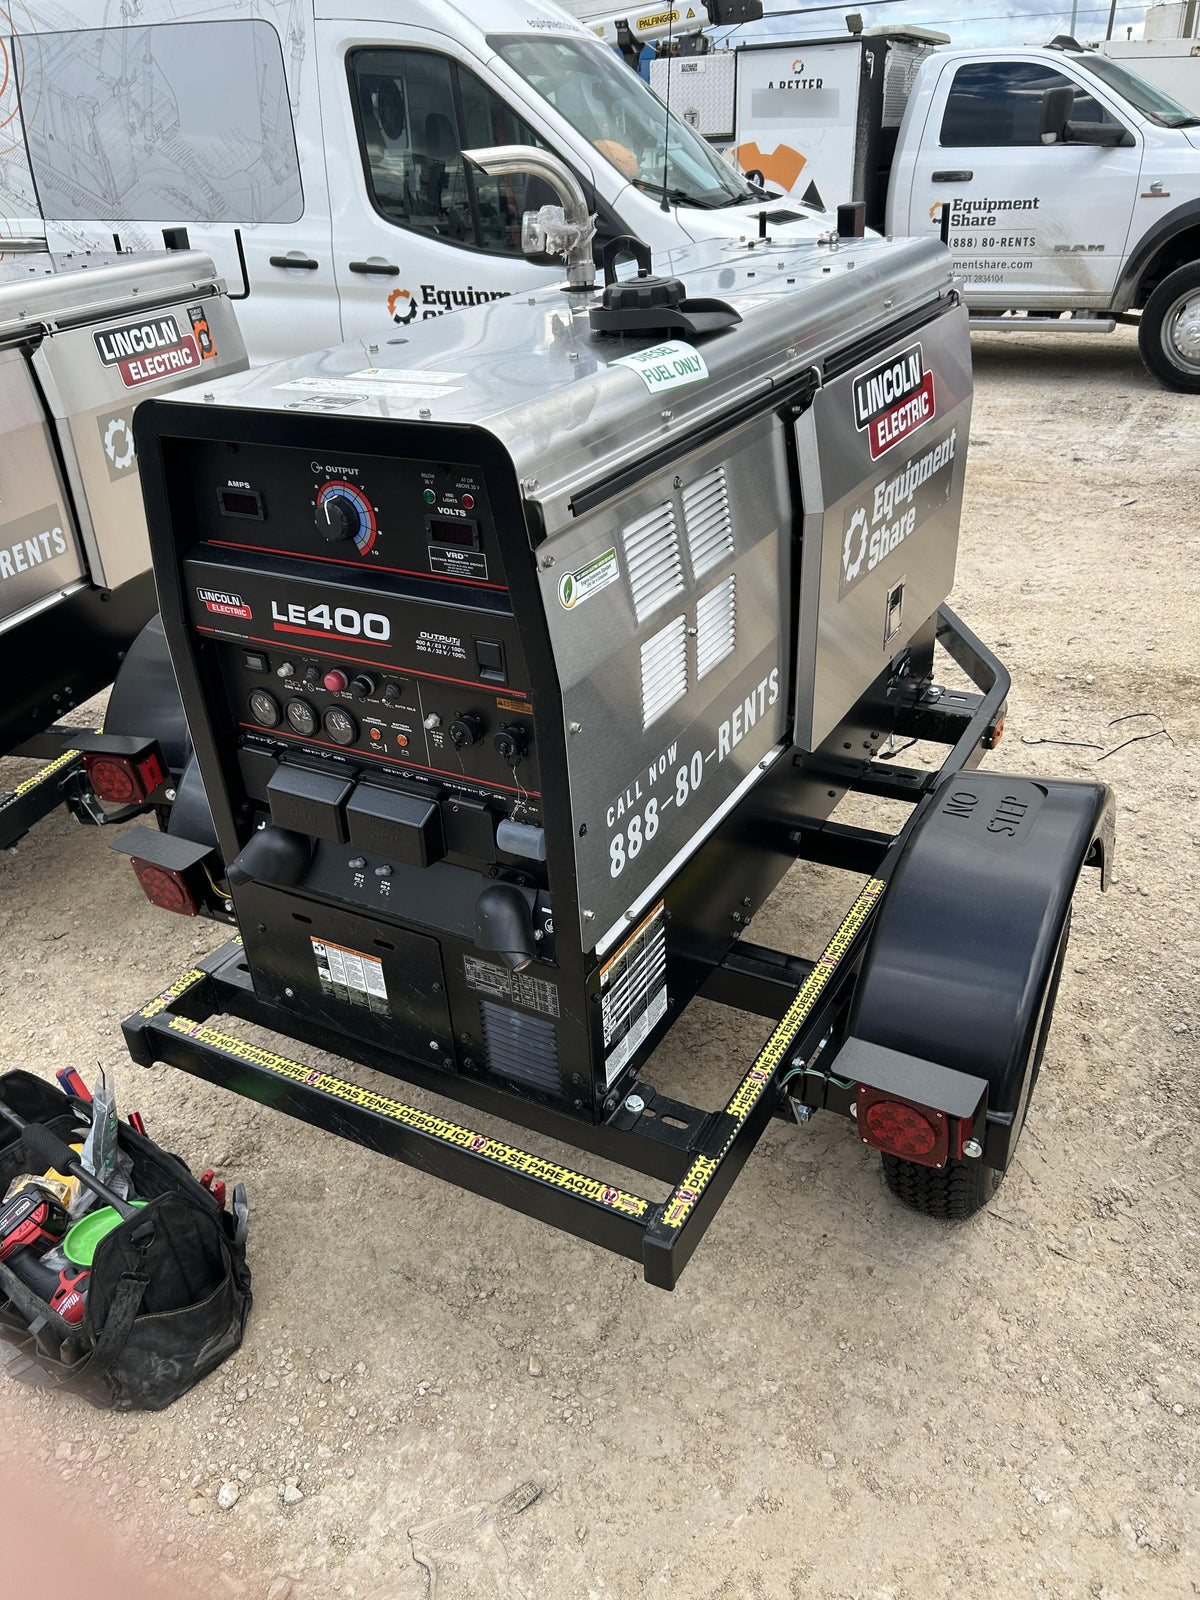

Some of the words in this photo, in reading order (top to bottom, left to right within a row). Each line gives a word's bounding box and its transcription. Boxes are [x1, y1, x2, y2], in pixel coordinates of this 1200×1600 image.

[639, 13, 677, 28] PALFINGER
[952, 197, 1040, 213] Equipment
[951, 214, 996, 227] Share
[982, 236, 1036, 248] 80-RENTS
[1054, 244, 1105, 252] RAM
[952, 259, 1033, 270] mentshare.com
[99, 320, 178, 361] LINCOLN
[631, 346, 679, 363] DIESEL
[128, 347, 193, 381] ELECTRIC
[641, 363, 675, 384] FUEL
[672, 355, 702, 376] ONLY
[857, 352, 921, 421] LINCOLN
[877, 391, 929, 447] ELECTRIC
[227, 480, 251, 489] AMPS
[325, 465, 359, 476] OUTPUT
[871, 428, 957, 526] Equipment
[437, 506, 466, 517] VOLTS
[868, 506, 916, 571] Share
[199, 589, 240, 606] LINCOLN
[212, 603, 247, 617] ELECTRIC
[271, 600, 390, 641] LE400
[420, 631, 457, 643] OUTPUT
[606, 780, 642, 828] CALL
[649, 741, 678, 786] NOW
[609, 667, 779, 878] 888-80-RENTS
[942, 792, 978, 819] NO
[987, 796, 1028, 837] STEP
[830, 944, 841, 957] NO
[838, 934, 847, 944] SE
[846, 915, 860, 934] PARE
[760, 1055, 775, 1071] NE
[769, 1038, 785, 1060] PAS
[782, 1011, 801, 1037] TENEZ
[797, 977, 821, 1010] DEBOUT
[819, 966, 829, 977] ICI
[201, 1030, 218, 1042] DO
[217, 1036, 241, 1050] NOT
[239, 1047, 277, 1066] STAND
[275, 1059, 308, 1078] HERE
[740, 1081, 759, 1110] HERE
[319, 1078, 338, 1090] NE
[336, 1085, 361, 1099] PAS
[362, 1094, 400, 1114] TENEZ
[400, 1109, 453, 1134] DEBOUT
[452, 1130, 469, 1143] ICI
[486, 1143, 507, 1158] NO
[507, 1152, 526, 1167] SE
[528, 1160, 566, 1181] PARE
[688, 1170, 704, 1189] DO
